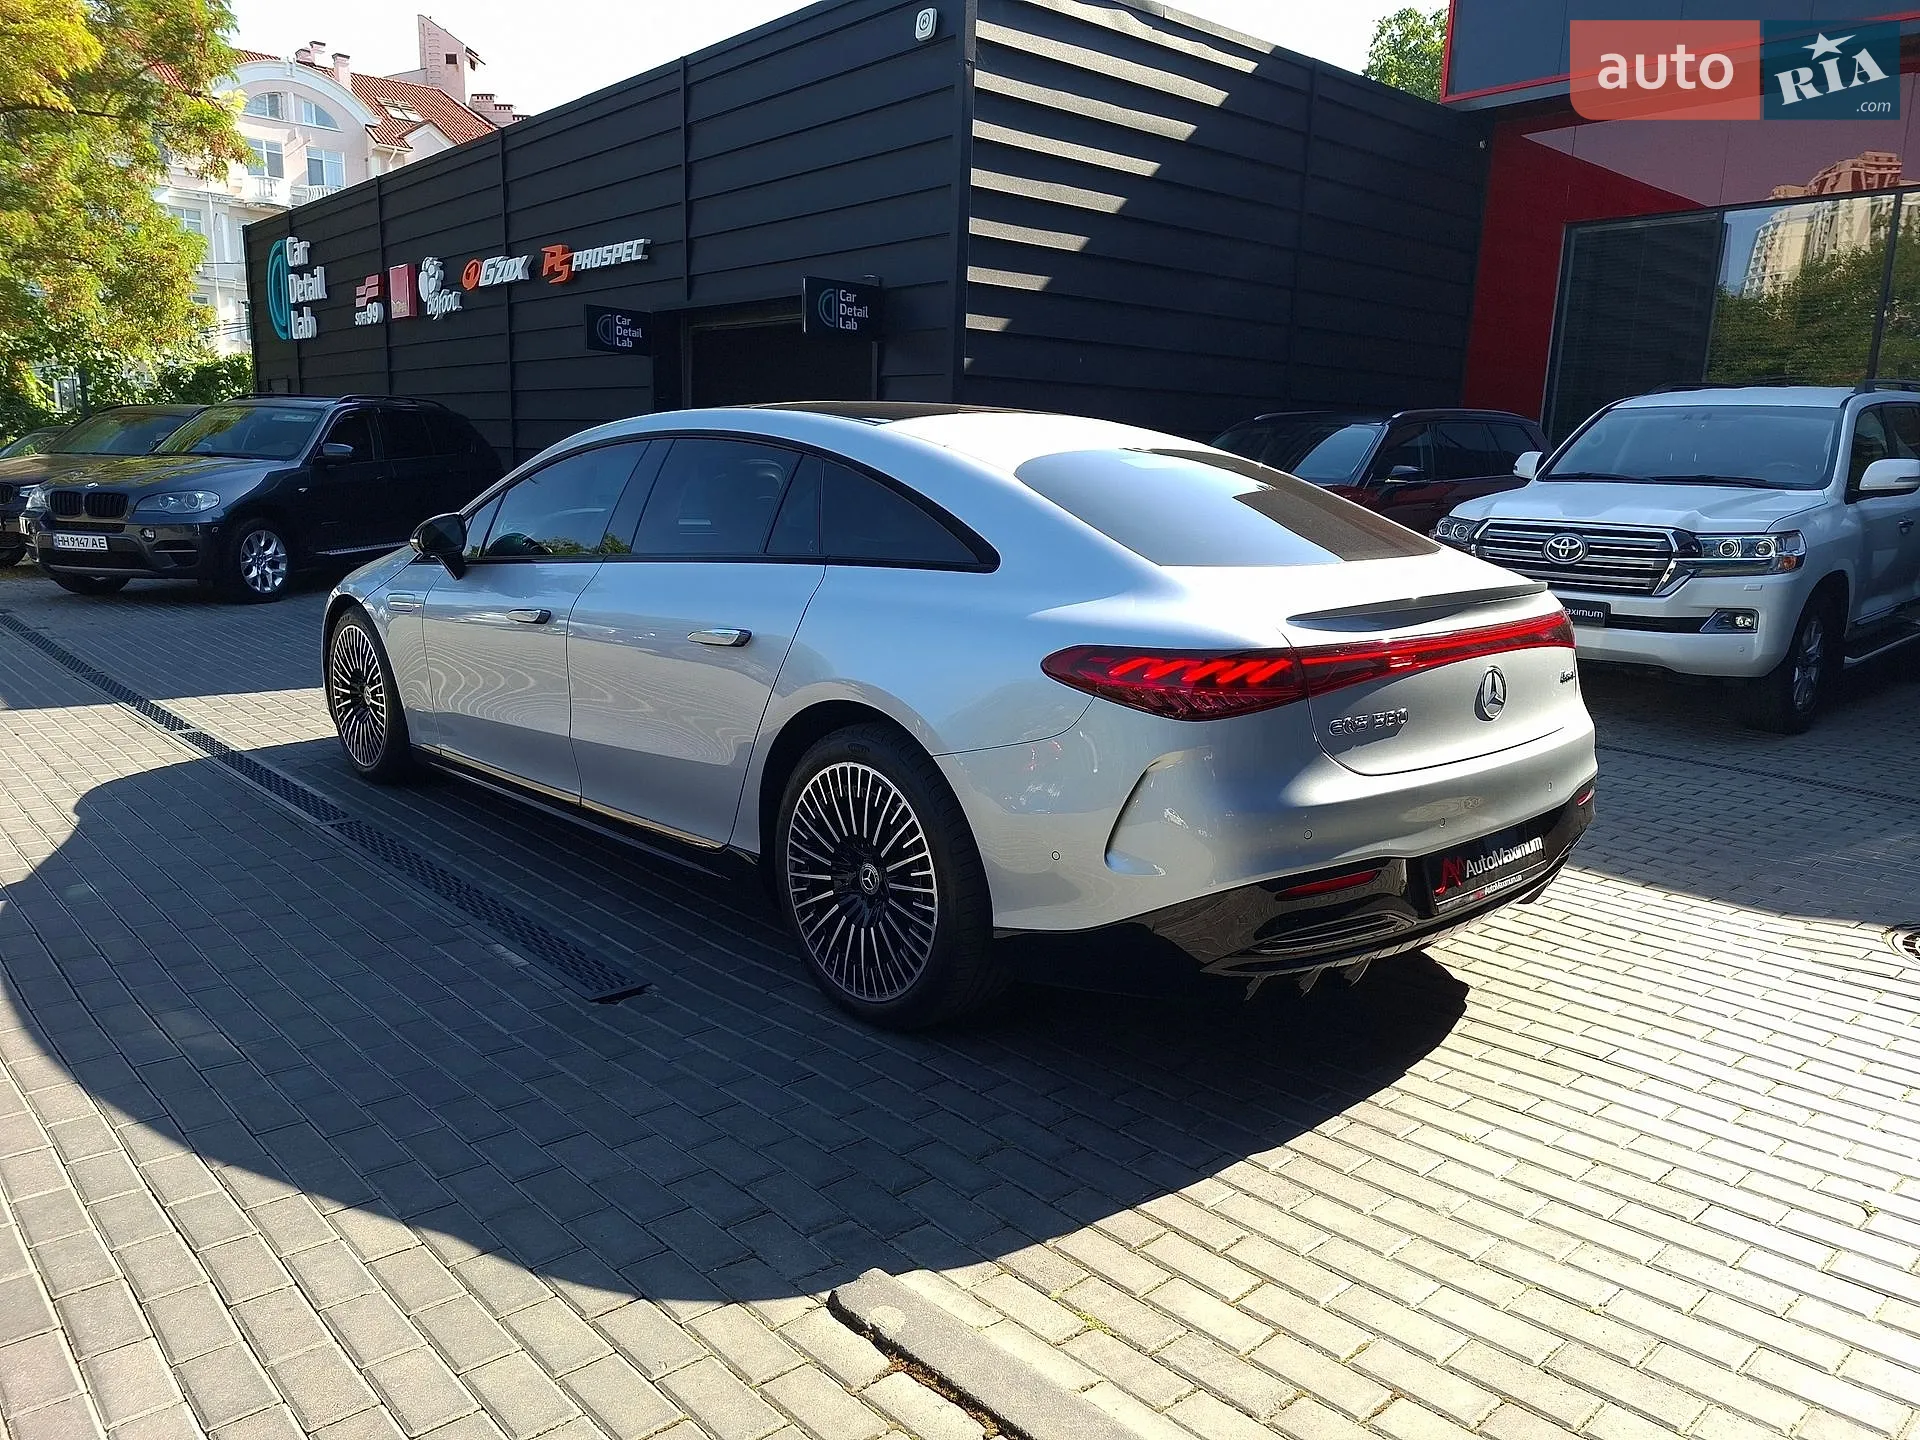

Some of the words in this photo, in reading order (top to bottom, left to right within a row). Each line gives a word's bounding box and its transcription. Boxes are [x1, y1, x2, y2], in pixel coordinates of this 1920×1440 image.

[286, 236, 311, 267] Car
[572, 238, 650, 272] PROSPEC
[288, 265, 328, 304] Detail
[840, 289, 857, 303] Car
[840, 303, 869, 319] Detail
[290, 306, 318, 340] Lab
[615, 314, 632, 327] Car
[840, 317, 858, 331] Lab
[616, 325, 643, 339] Detail
[616, 337, 633, 348] Lab
[1564, 606, 1604, 619] aximum
[1465, 836, 1544, 879] AutoMaximum
